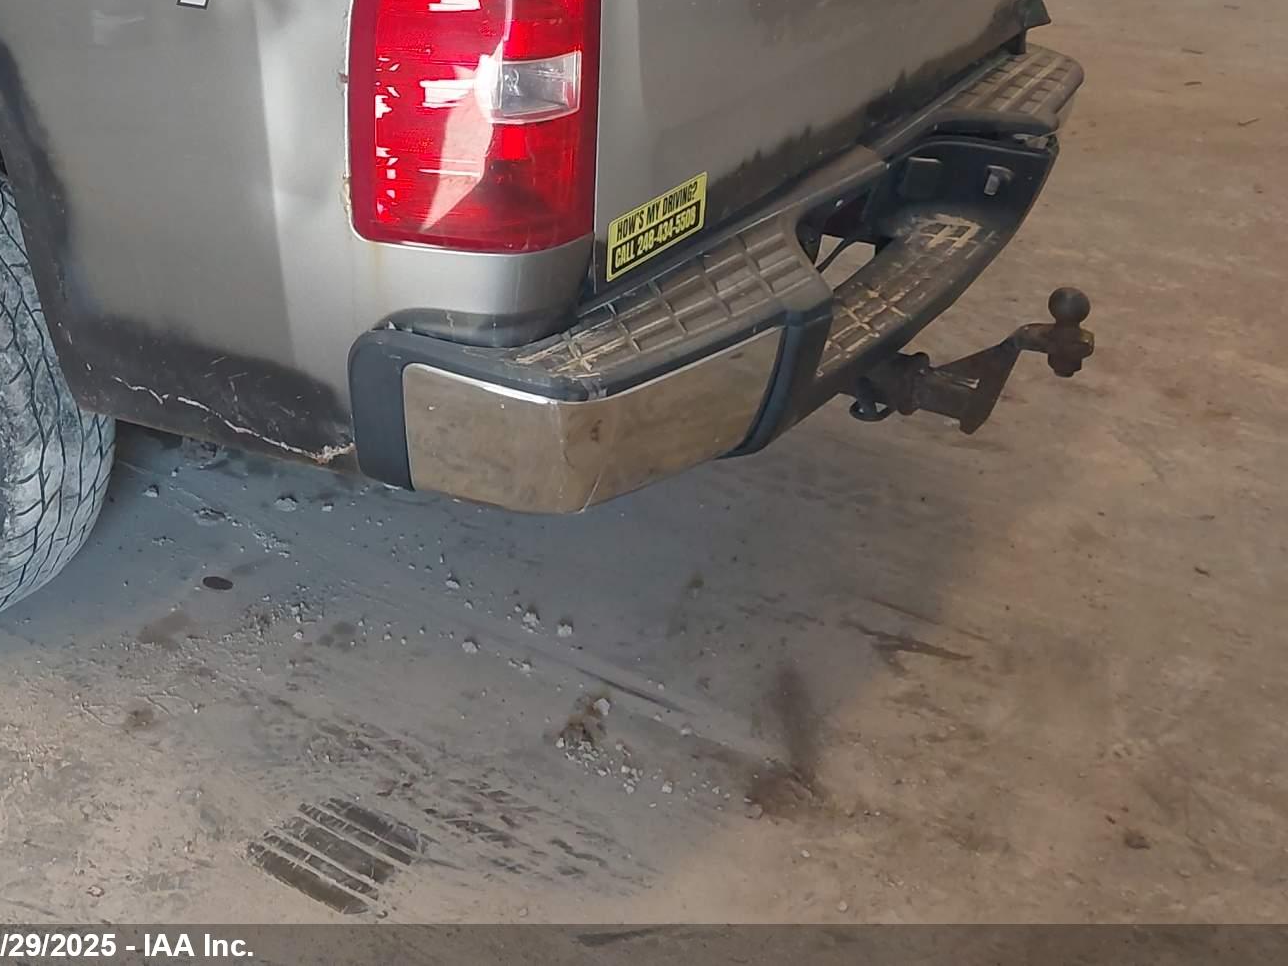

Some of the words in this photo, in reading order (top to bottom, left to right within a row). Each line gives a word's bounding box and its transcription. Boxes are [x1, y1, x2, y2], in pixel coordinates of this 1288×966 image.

[616, 209, 645, 243] HOW'S
[647, 199, 662, 225] MY
[662, 180, 698, 217] DRIVING?
[615, 240, 636, 269] CALL
